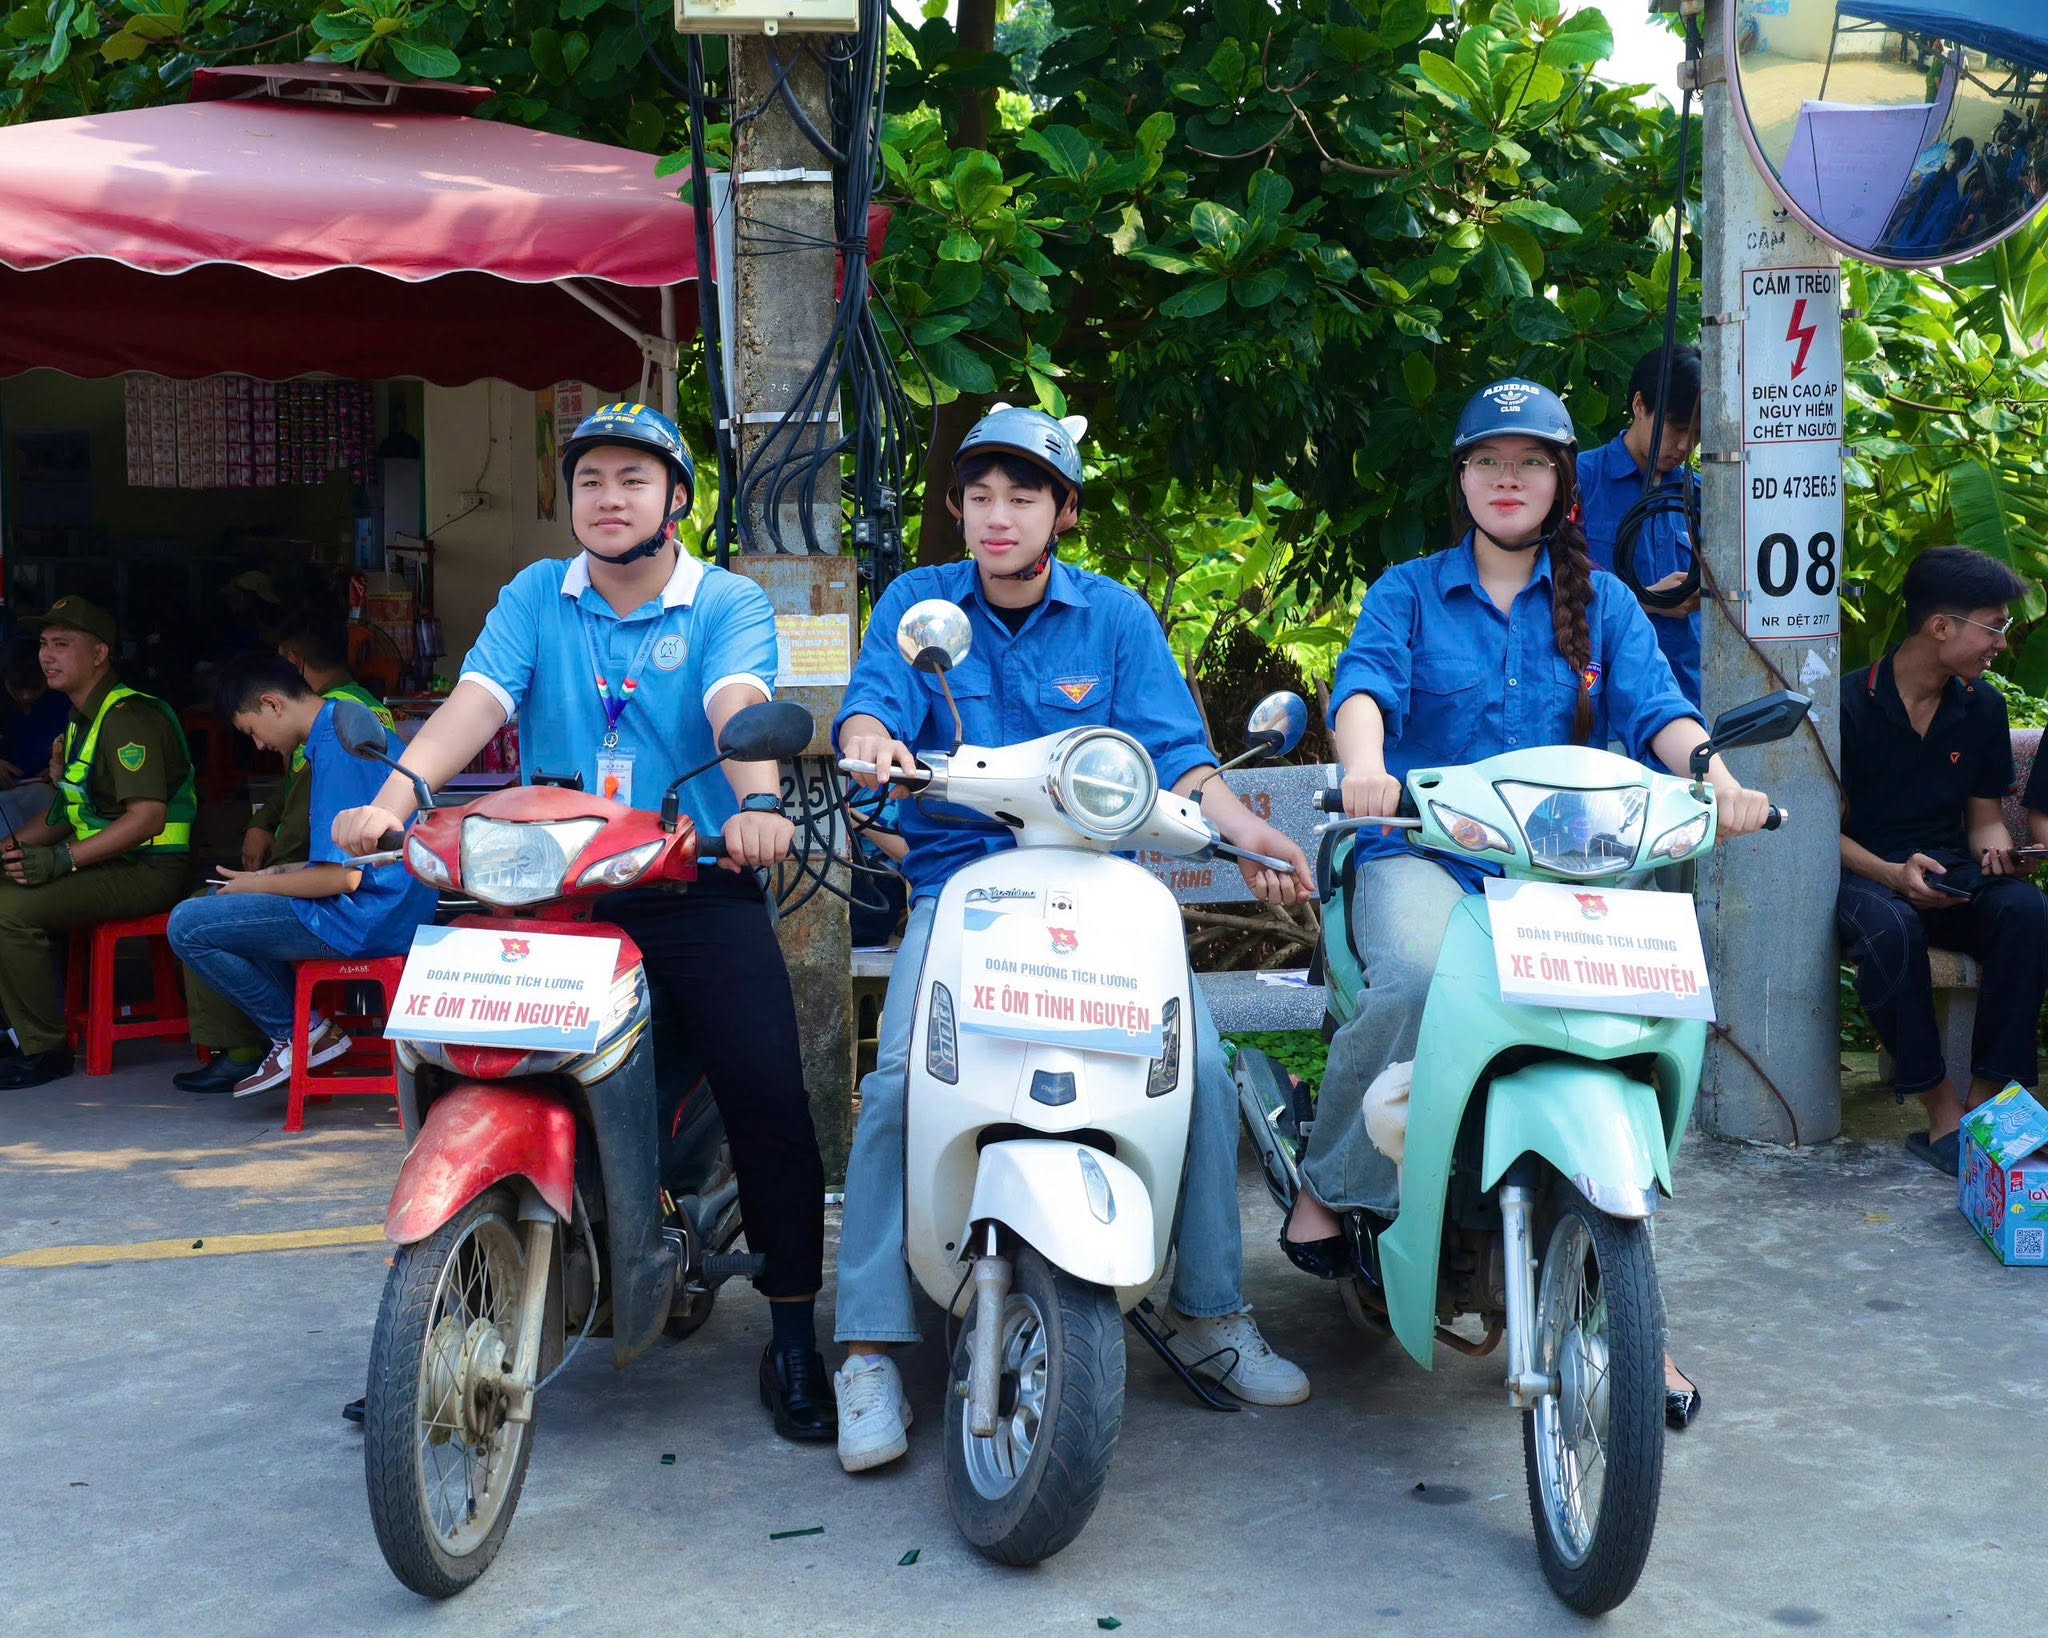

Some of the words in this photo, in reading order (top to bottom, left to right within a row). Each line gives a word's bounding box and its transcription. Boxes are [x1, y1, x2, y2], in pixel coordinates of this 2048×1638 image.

[1752, 271, 1791, 296] CẤM
[1482, 383, 1540, 398] ADIDAS
[1752, 383, 1788, 403] ĐIỆN
[1792, 383, 1821, 398] CAO
[1824, 380, 1838, 397] ÁP
[1500, 405, 1521, 413] CLUB
[1759, 404, 1802, 420] NGUY
[1805, 399, 1833, 417] HIỂM
[1753, 421, 1794, 439] CHẾT
[1797, 419, 1837, 437] NGƯỜI
[1752, 477, 1778, 500] ĐD
[1783, 474, 1837, 499] 473E6.5
[1756, 531, 1836, 598] 08
[1761, 616, 1780, 627] NR
[1787, 613, 1811, 628] DỆT
[1812, 614, 1831, 625] 27/7
[1636, 937, 1678, 952] LƯƠNG
[426, 968, 460, 982] ĐOÀN
[463, 970, 512, 986] PHƯỜNG
[544, 976, 584, 991] LƯƠNG
[1020, 962, 1068, 980] PHƯỜNG
[1100, 973, 1138, 990] LƯƠNG
[1510, 953, 1536, 979] XE
[1540, 951, 1571, 982] ÔM
[1573, 955, 1618, 987] TÌNH
[1621, 963, 1698, 998] NGUYỆN
[404, 993, 431, 1016] XE
[433, 991, 466, 1019] ÔM
[469, 994, 512, 1022] TÌNH
[514, 1000, 590, 1032] NGUYỆN
[972, 984, 996, 1011] XE
[1001, 983, 1029, 1015] ÔM
[1034, 989, 1075, 1021] TÌNH
[1080, 1000, 1150, 1035] NGUYỆN
